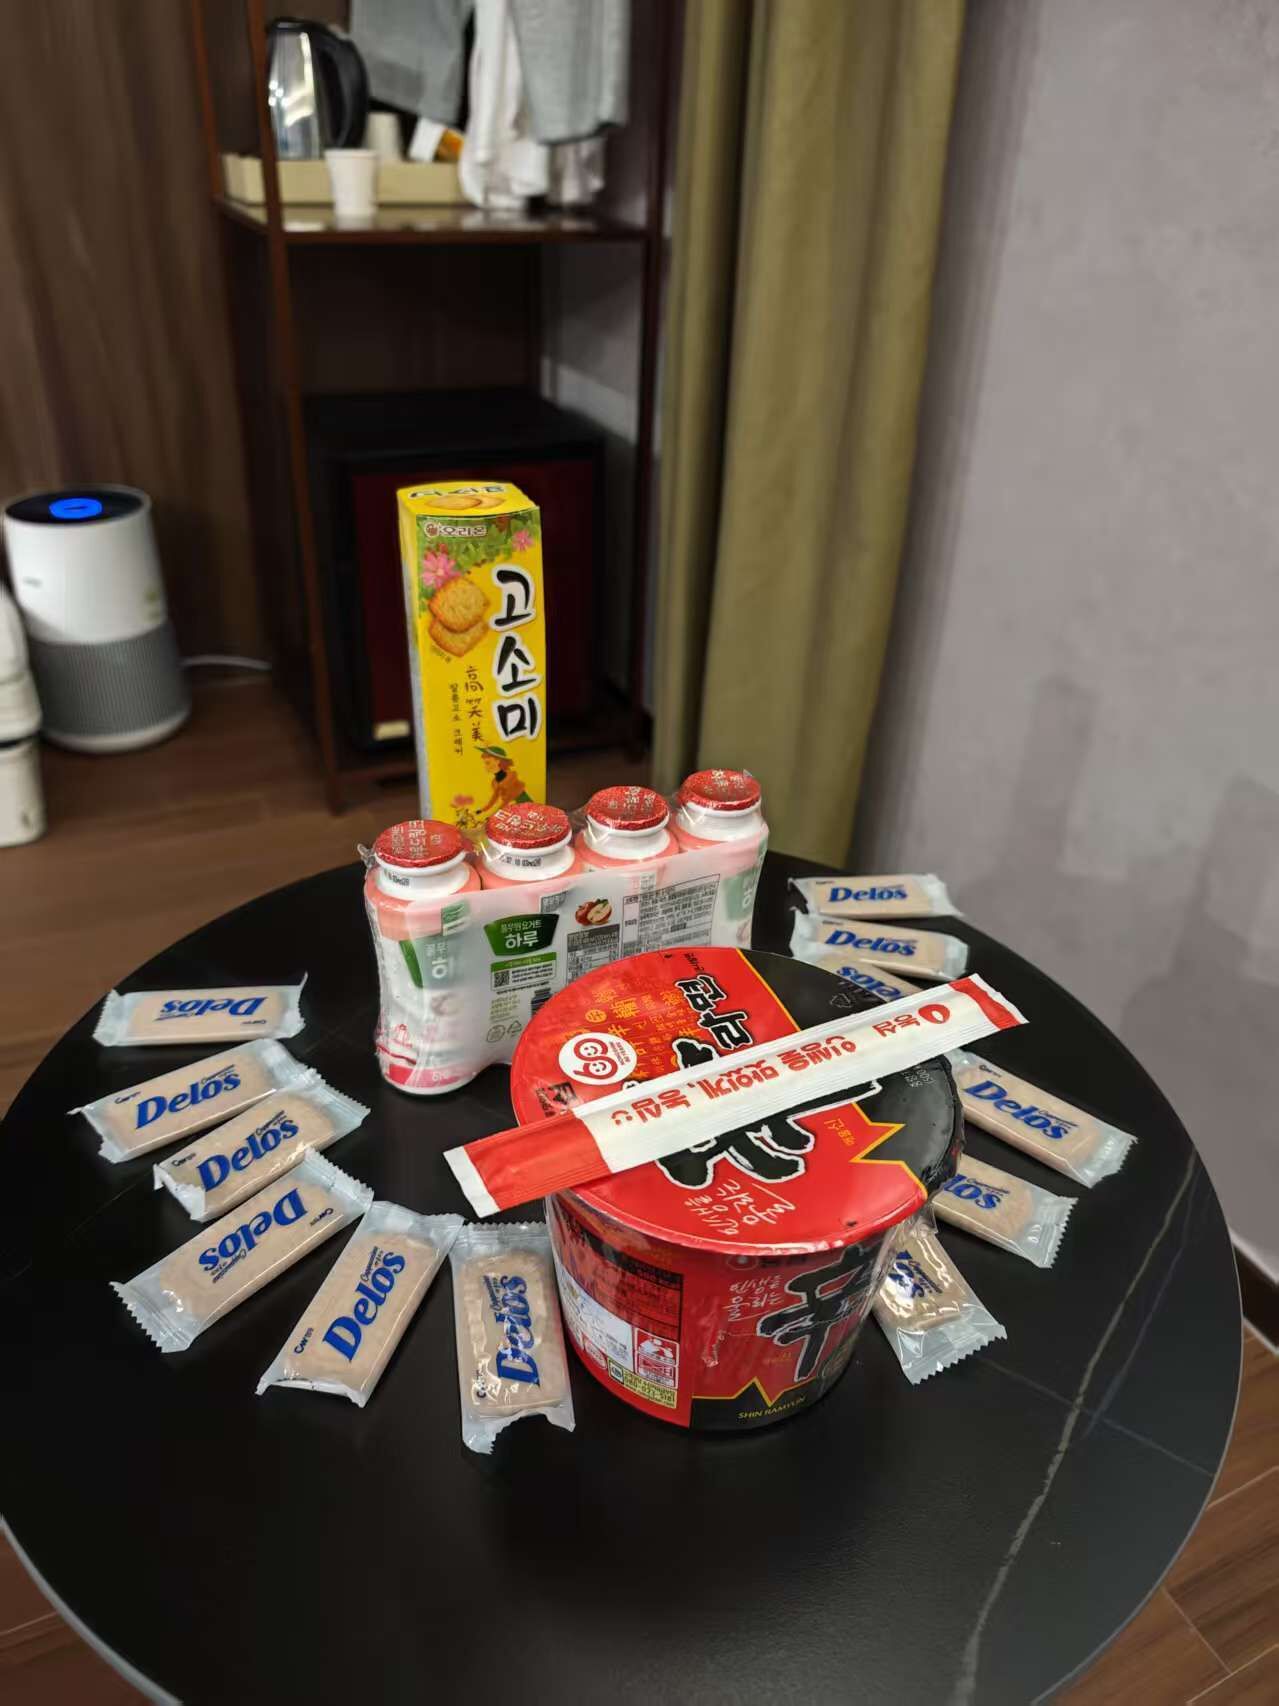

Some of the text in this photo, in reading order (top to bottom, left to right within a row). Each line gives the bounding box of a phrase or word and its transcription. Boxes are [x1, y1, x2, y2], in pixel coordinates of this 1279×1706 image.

[493, 568, 539, 738] 고소미
[829, 886, 908, 902] Delos
[505, 931, 539, 950] 하루
[825, 929, 917, 956] Delos
[836, 966, 902, 999] elos
[160, 996, 268, 1017] Delos
[675, 974, 754, 1050] 라면
[872, 1014, 922, 1038] 농심
[778, 1035, 857, 1072] 인생을
[687, 1059, 779, 1100] 맛있게,
[135, 1072, 241, 1130] Delos
[631, 1089, 692, 1124] 농심
[963, 1080, 1069, 1139] Delos
[196, 1119, 299, 1192] Delos
[943, 1173, 1002, 1209] los
[198, 1187, 308, 1272] Delos
[322, 1251, 405, 1363] Delos
[496, 1275, 540, 1387] Delos
[738, 1410, 762, 1420] SHIN
